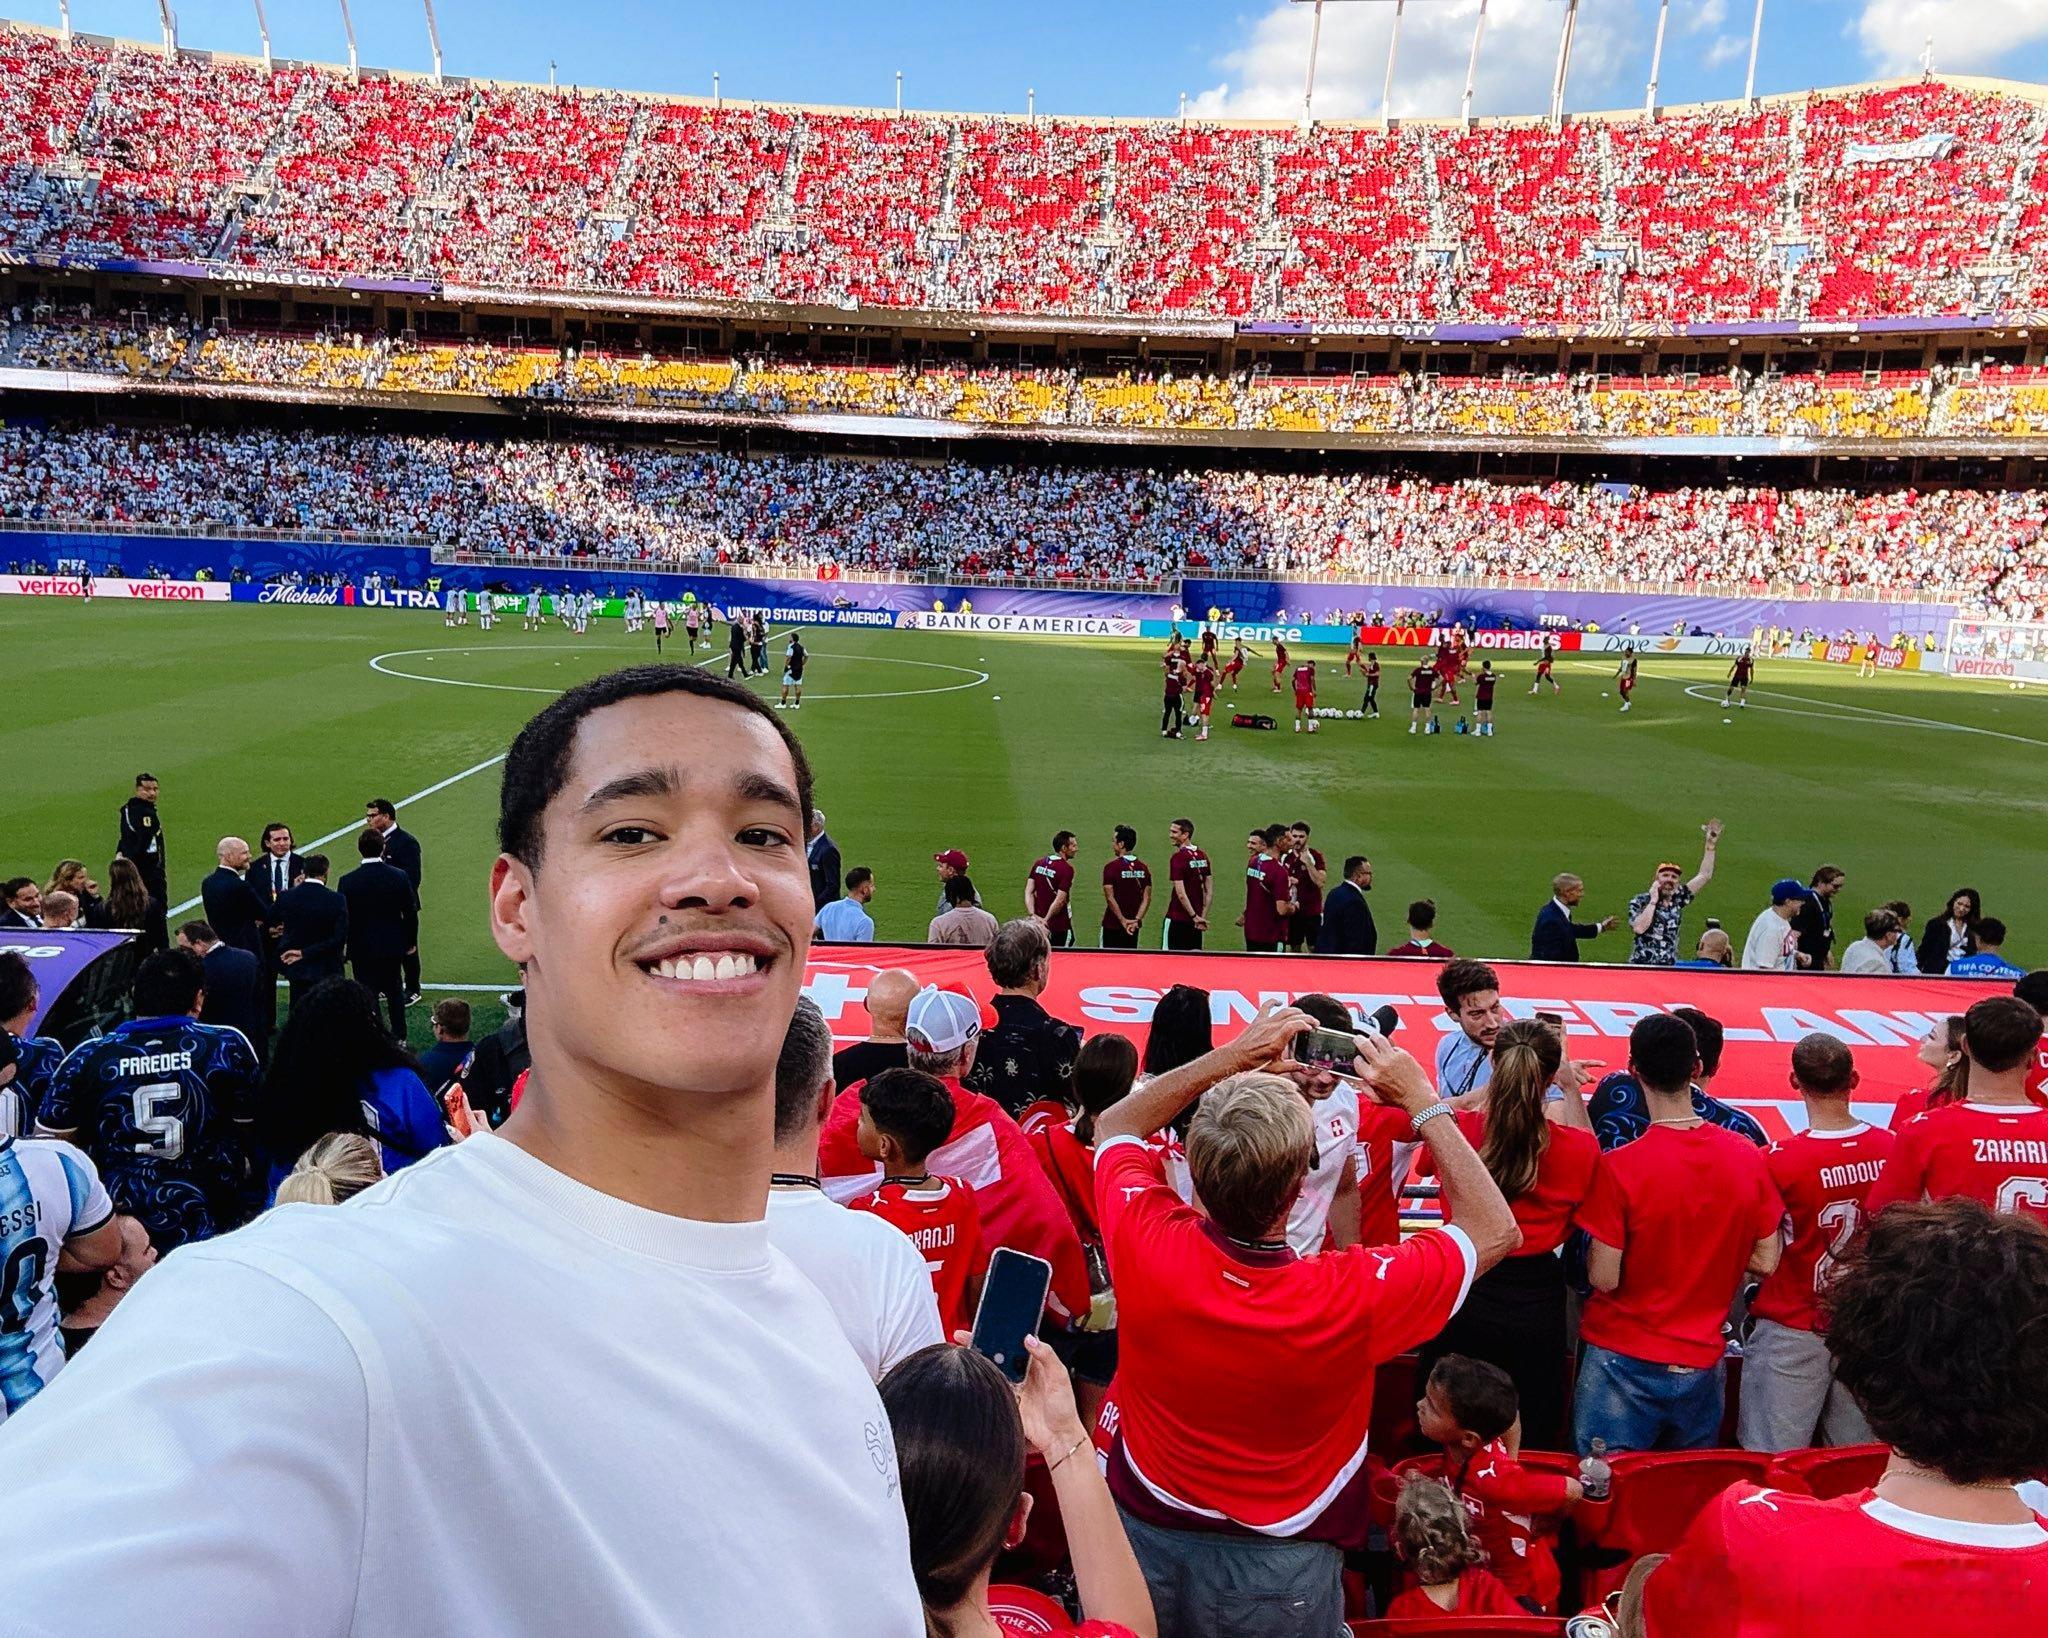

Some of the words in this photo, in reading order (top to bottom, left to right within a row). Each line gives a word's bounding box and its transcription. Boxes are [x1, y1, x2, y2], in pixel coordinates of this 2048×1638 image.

[208, 268, 294, 285] KANSAS
[297, 274, 344, 288] CITY
[1311, 323, 1390, 336] KANSAS
[1392, 324, 1437, 336] CITY
[127, 579, 205, 600] verizon
[258, 583, 338, 604] Michelob
[361, 588, 441, 609] ULTRA
[727, 605, 772, 620] UNITD
[773, 606, 818, 622] STATES
[819, 609, 836, 623] OF
[836, 610, 893, 626] AMERICA
[926, 614, 981, 629] BANK
[988, 616, 1013, 631] OF
[1018, 617, 1110, 634] AMERICA
[1539, 614, 1569, 627] FIFA
[1197, 620, 1302, 642] Hisense
[1428, 627, 1562, 650] Monald's
[1602, 633, 1650, 652] Dove
[1954, 655, 2016, 677] verizon
[119, 1051, 192, 1077] PAREDES
[132, 1082, 185, 1160] 5
[1972, 1138, 2048, 1164] ZAKARI
